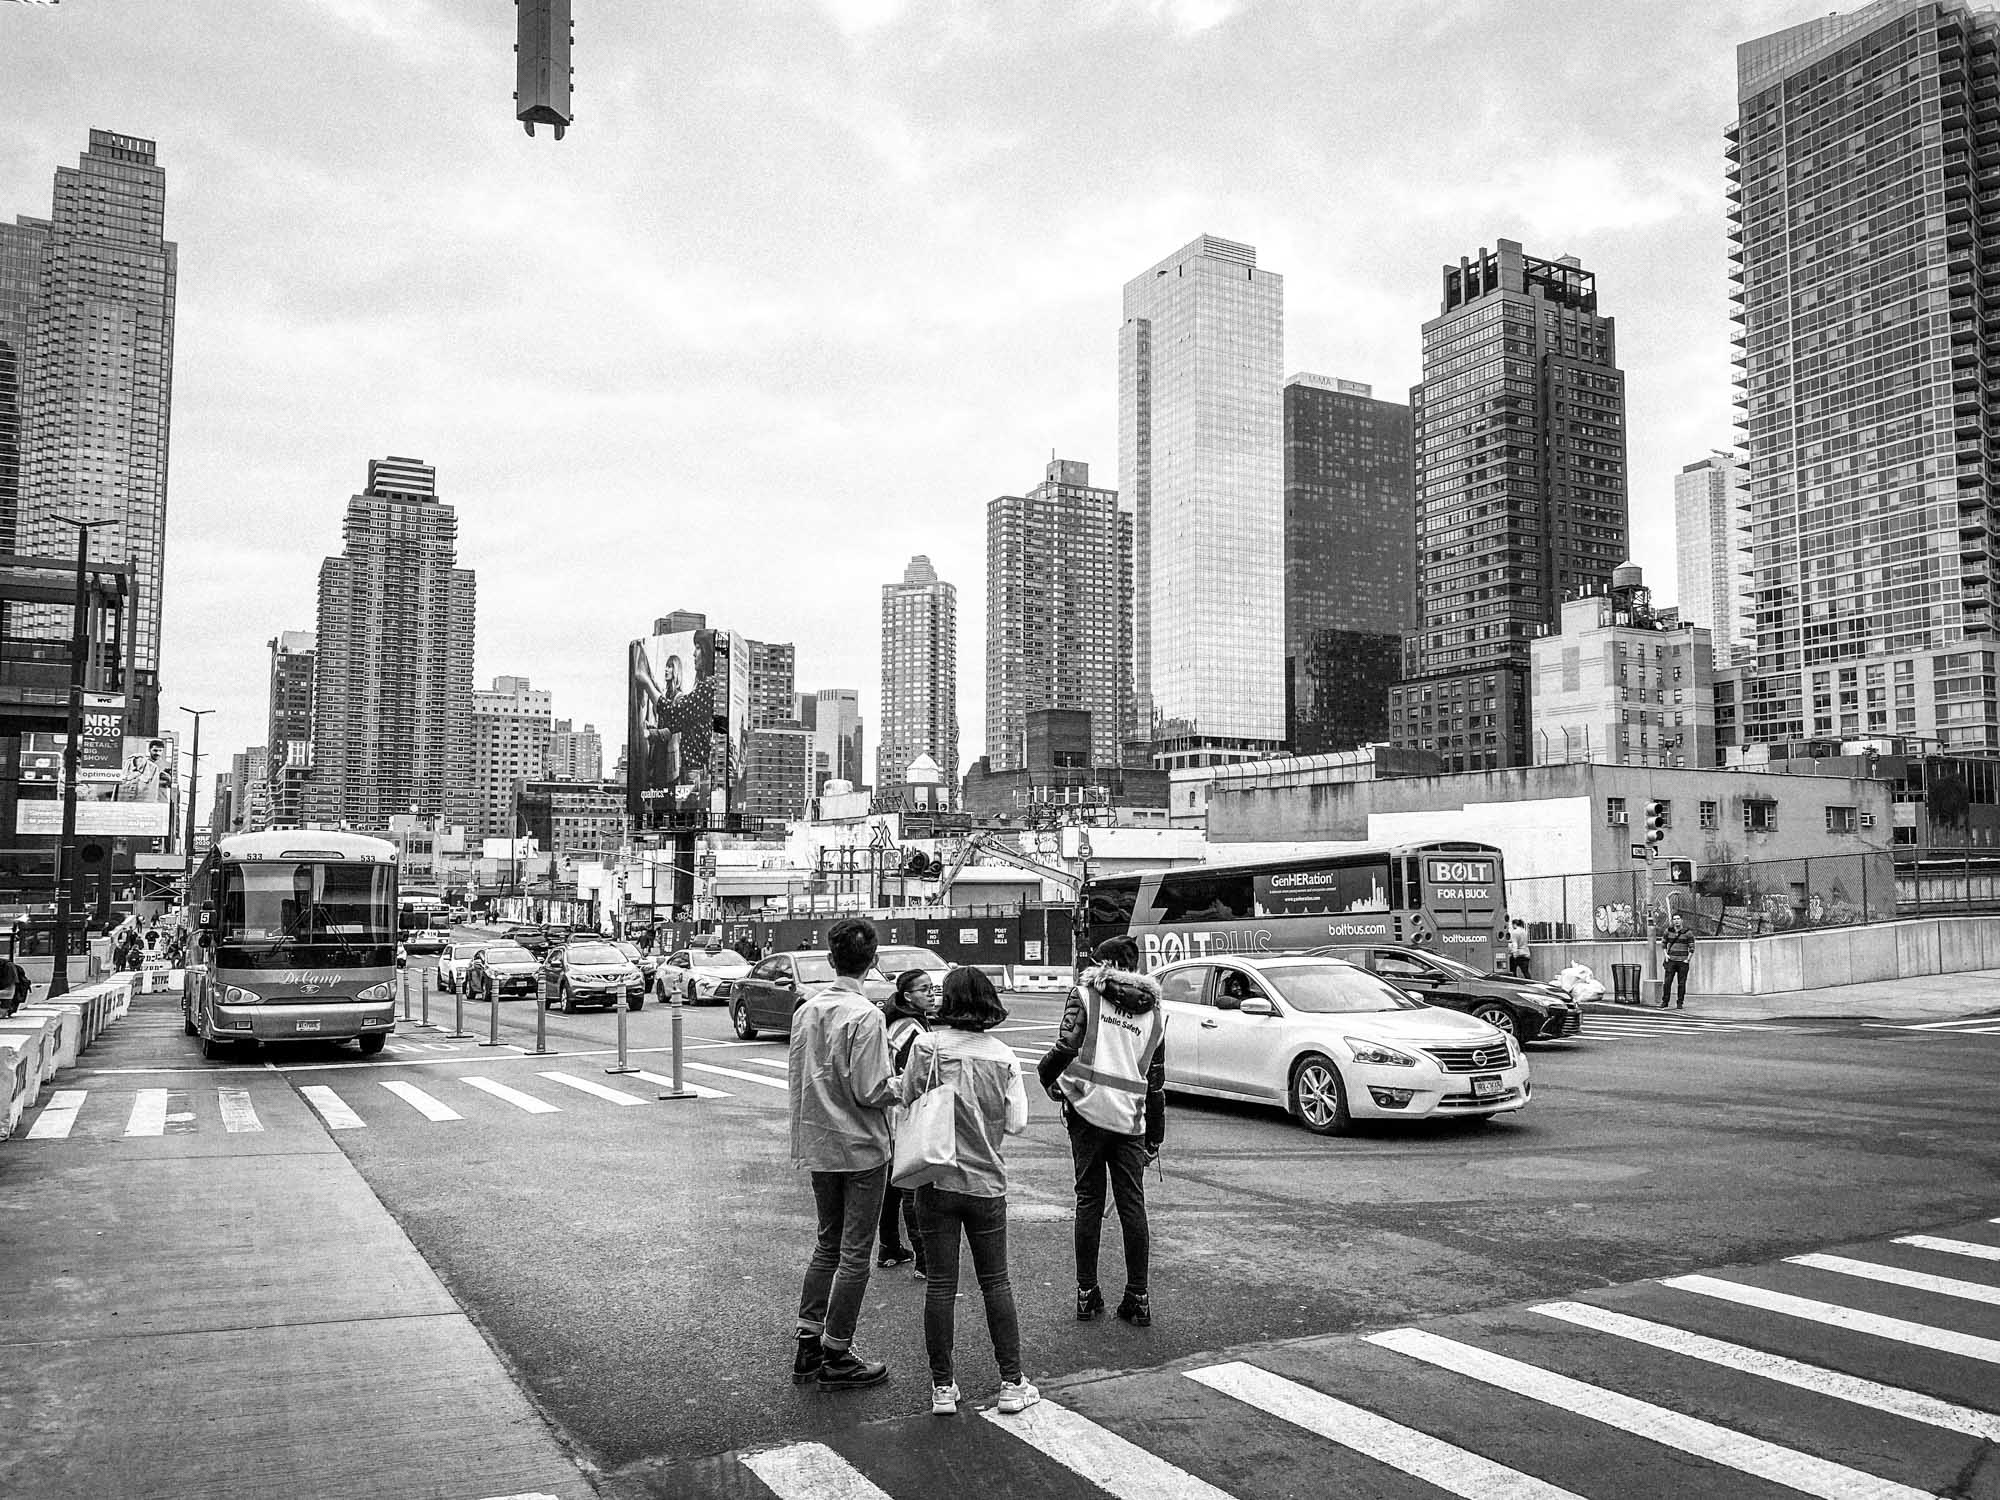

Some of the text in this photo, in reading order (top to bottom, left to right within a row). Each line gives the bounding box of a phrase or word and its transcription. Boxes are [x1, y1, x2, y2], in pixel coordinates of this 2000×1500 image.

[84, 714, 123, 727] NRF
[83, 727, 121, 737] 2020
[84, 741, 118, 749] RETAIL'S
[675, 787, 690, 799] SAP
[1436, 862, 1487, 881] BOLT
[1271, 872, 1333, 887] GenHERation
[1437, 889, 1456, 899] FOR
[1457, 889, 1464, 898] A
[201, 913, 209, 922] 5
[1328, 923, 1386, 936] boltbus.com
[1442, 934, 1488, 943] boltbus.com
[281, 970, 342, 987] DeCamp
[1101, 1014, 1141, 1036] Public Safety
